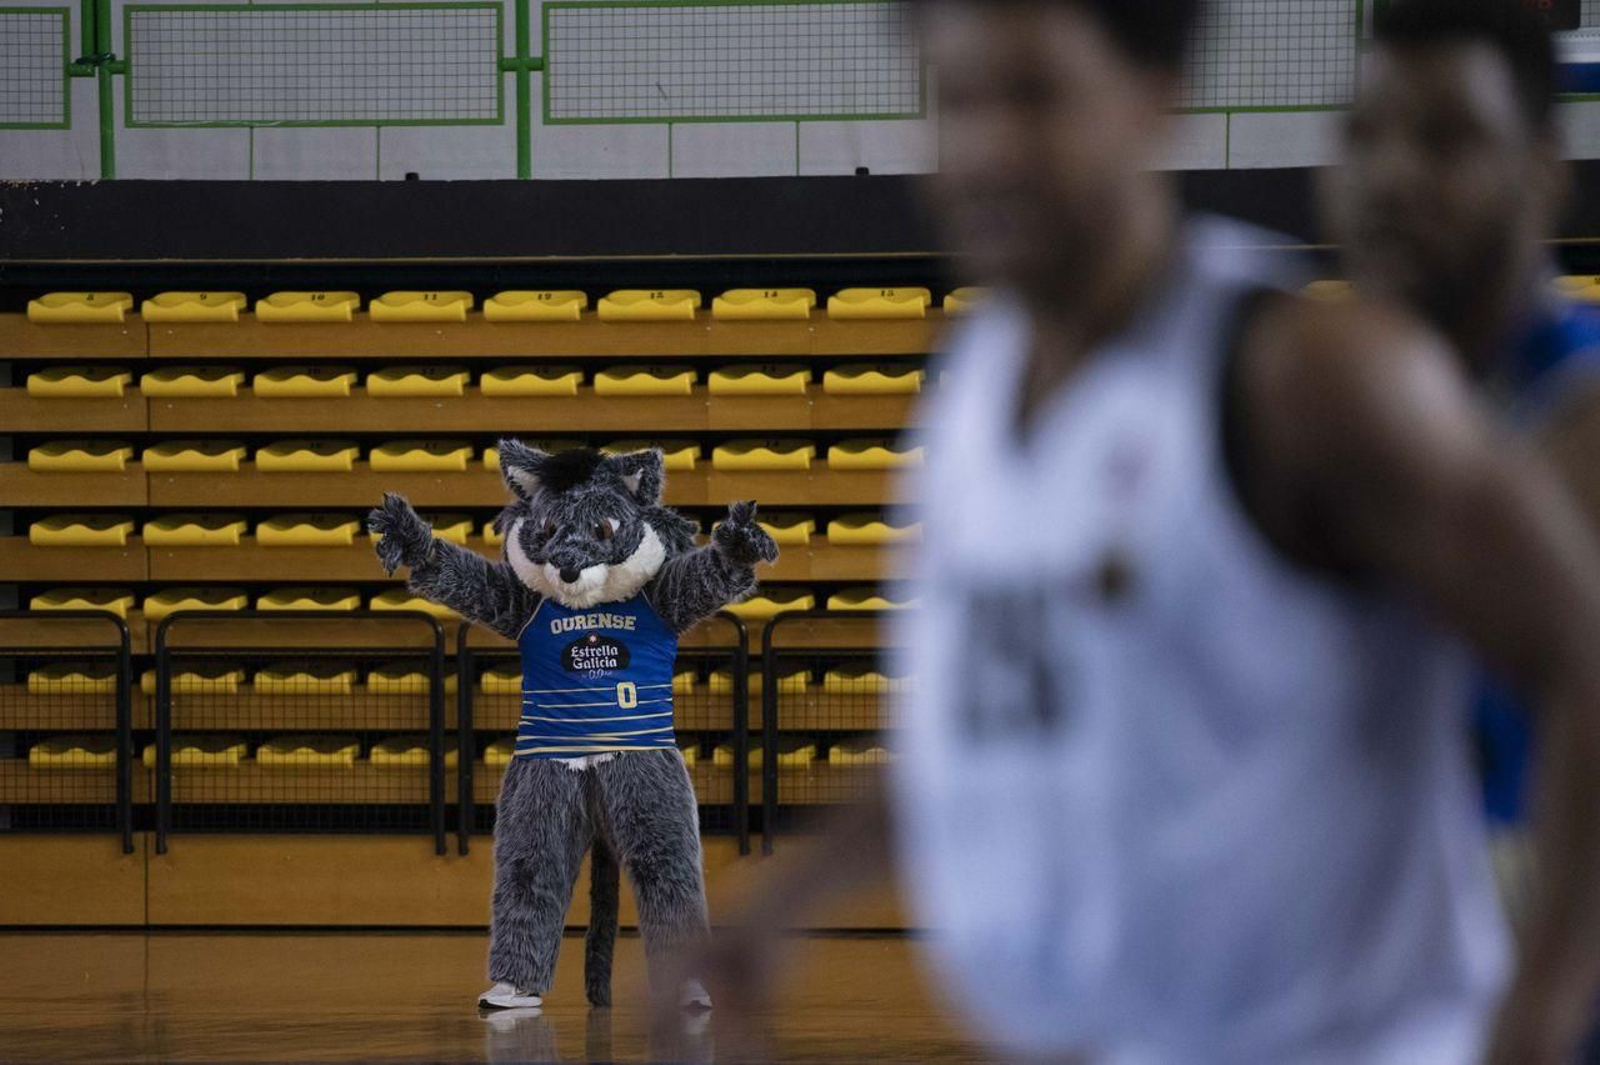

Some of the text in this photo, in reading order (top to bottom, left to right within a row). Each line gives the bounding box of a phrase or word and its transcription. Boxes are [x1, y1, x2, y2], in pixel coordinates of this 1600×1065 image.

[311, 293, 325, 301] 10
[423, 293, 437, 301] 11
[550, 613, 637, 635] OURENSE
[570, 645, 619, 658] Estrella
[572, 656, 618, 670] Galicia
[616, 681, 638, 709] 0
